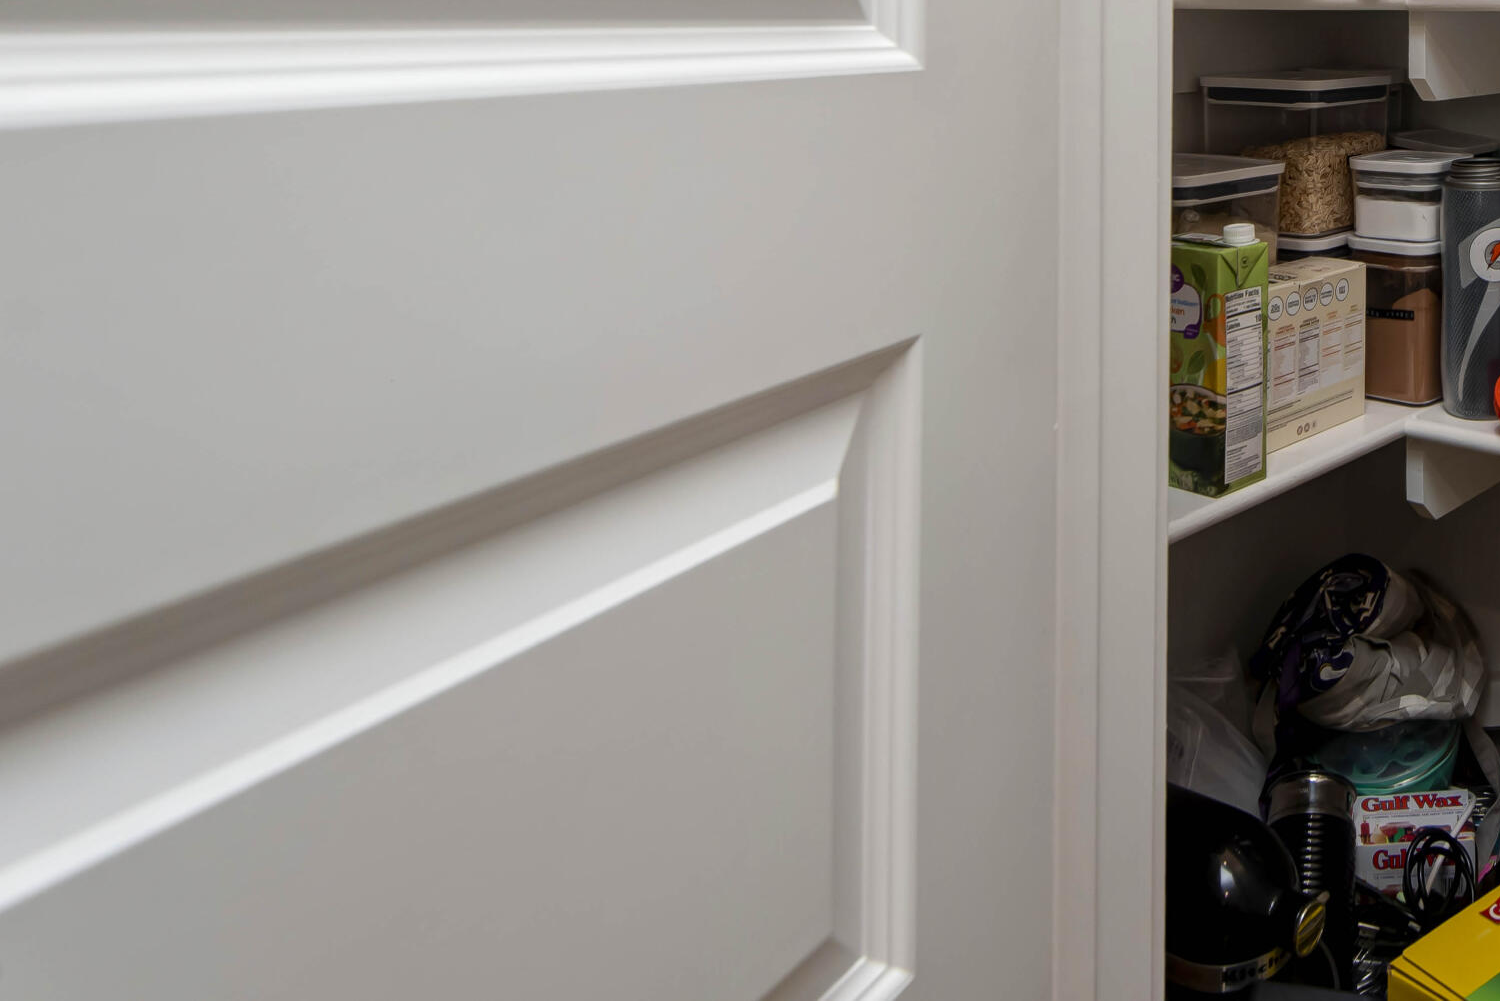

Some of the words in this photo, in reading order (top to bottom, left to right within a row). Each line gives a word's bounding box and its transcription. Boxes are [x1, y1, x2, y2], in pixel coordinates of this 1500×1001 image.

[1361, 795, 1410, 812] Gulf
[1411, 793, 1463, 809] Wax
[1373, 849, 1406, 870] Gul
